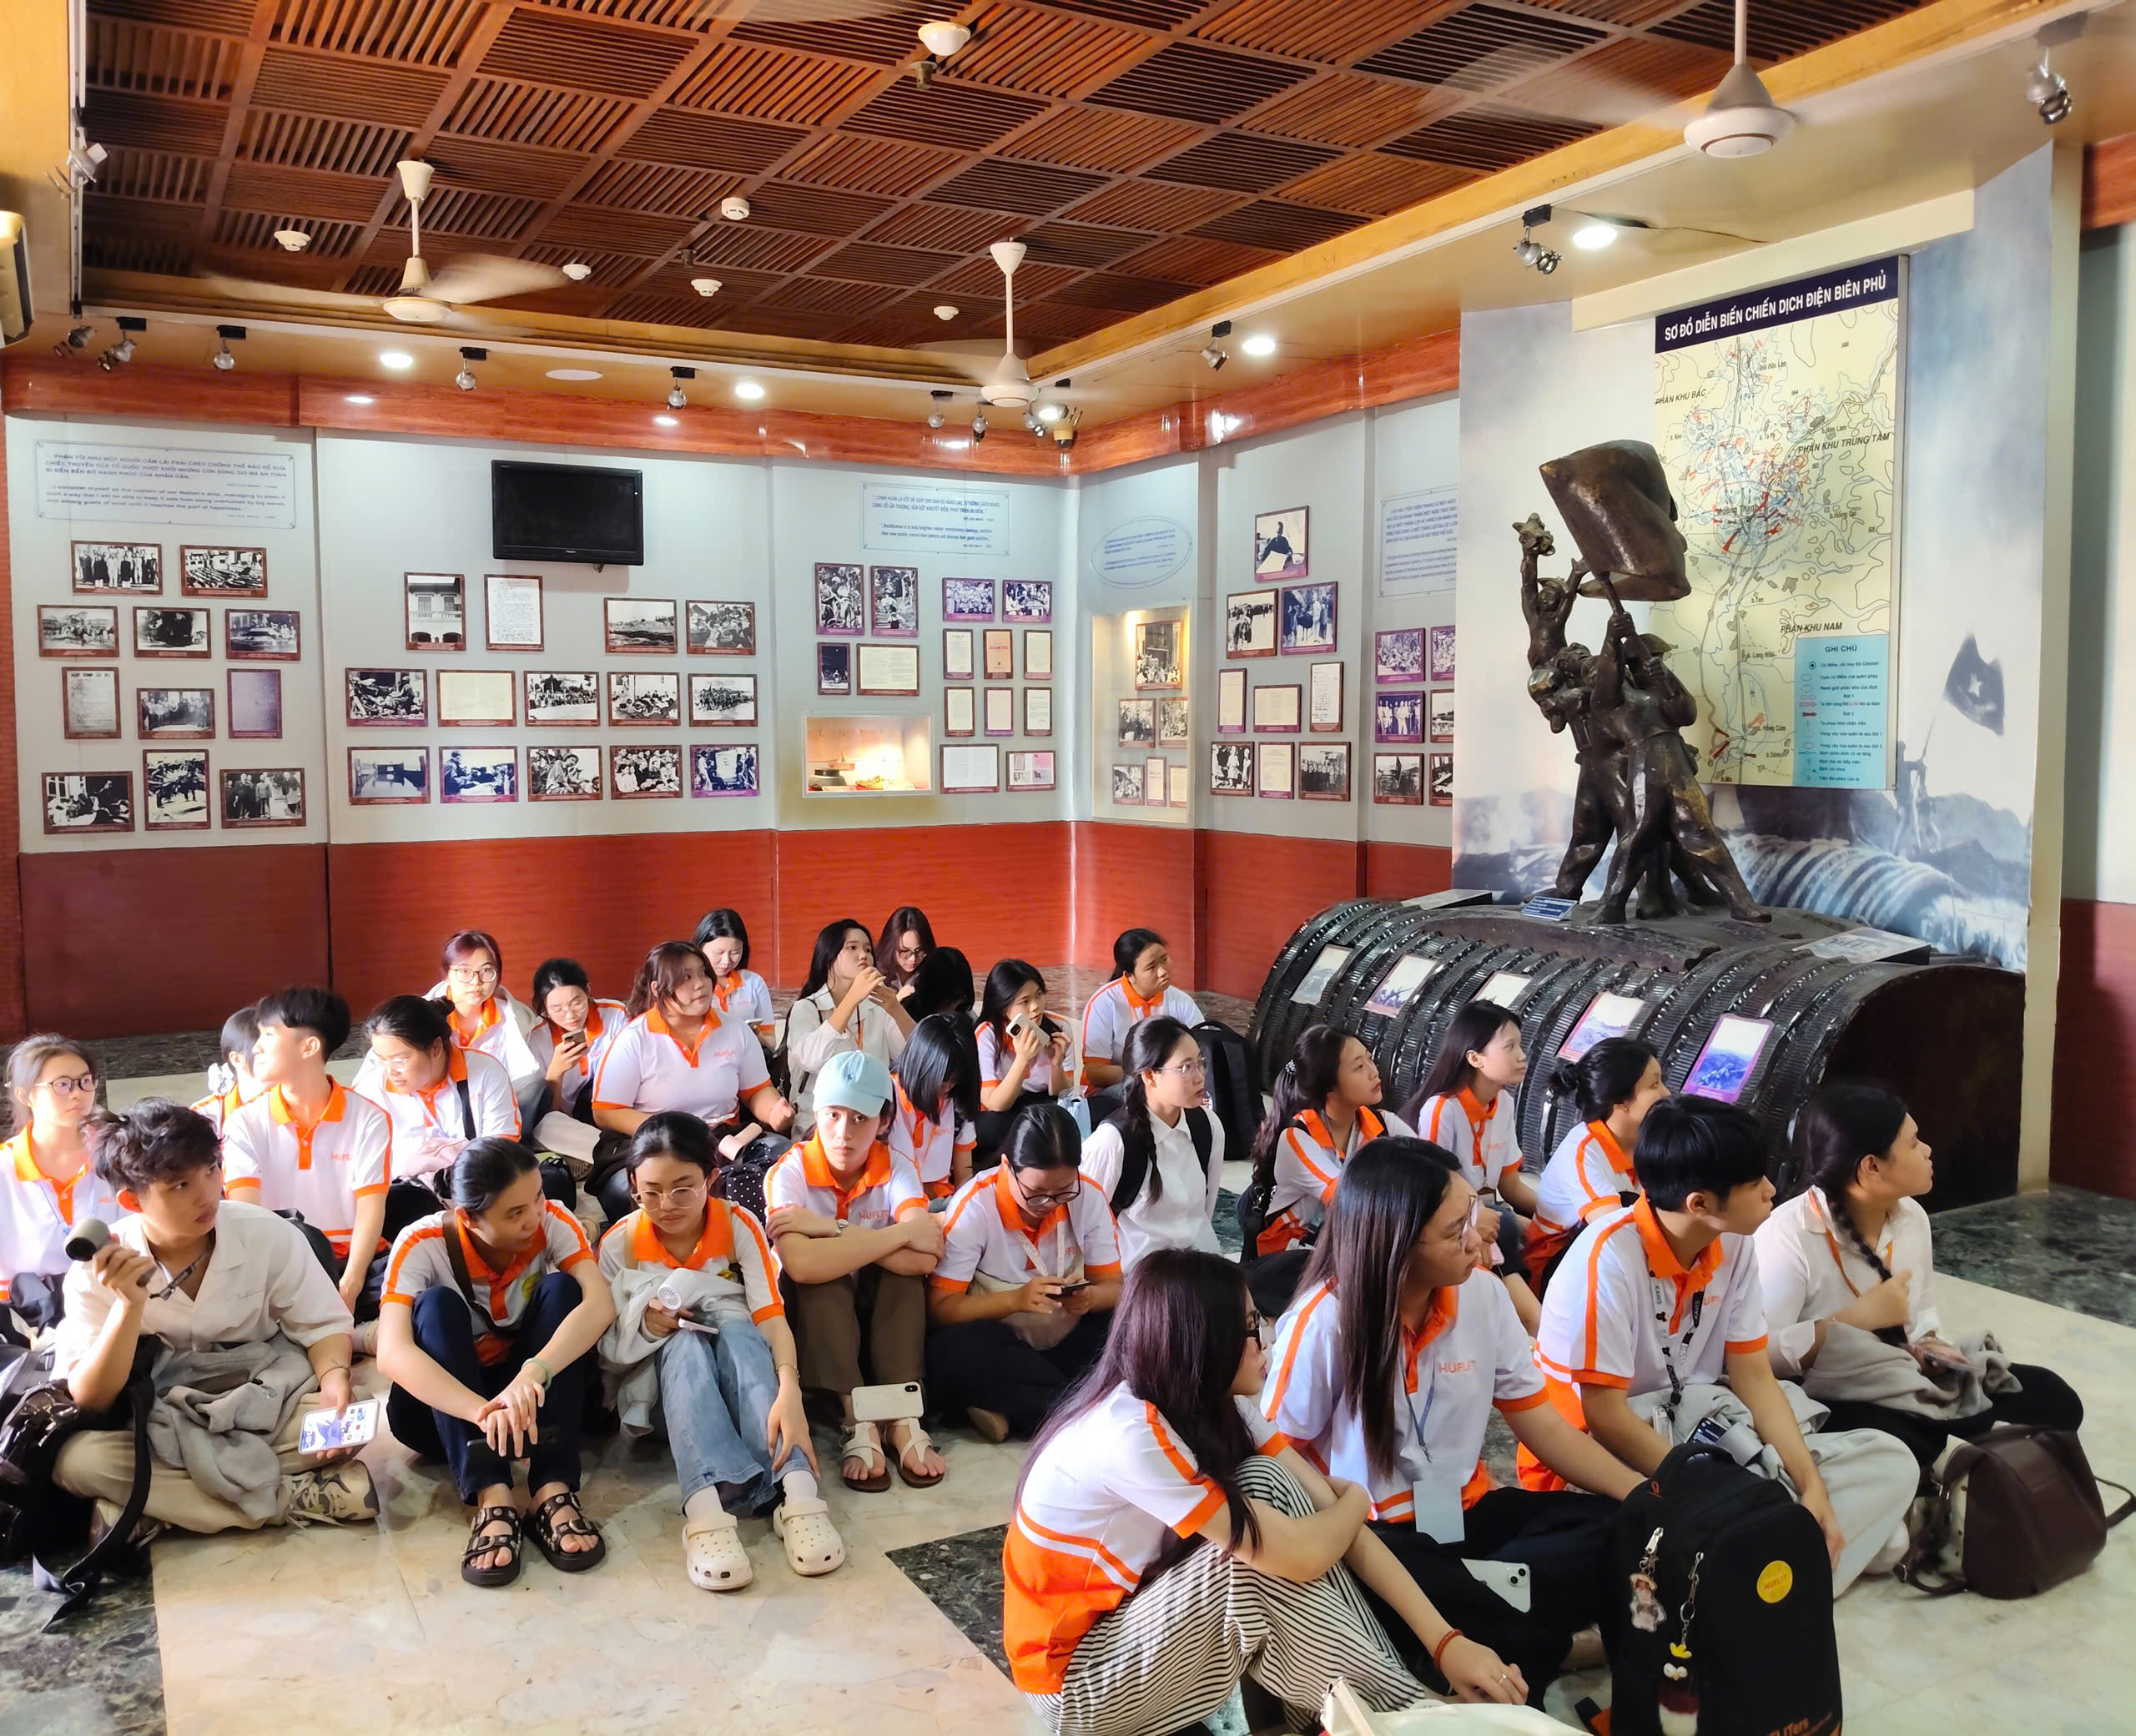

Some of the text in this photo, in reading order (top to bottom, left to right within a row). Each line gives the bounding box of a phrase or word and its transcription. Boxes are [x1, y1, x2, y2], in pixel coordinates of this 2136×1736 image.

[1665, 269, 1886, 341] SƠ ĐỒ DIỄN BIẾN CHIẾN DỊCH ĐIỆN BIÊN PHỦ
[1676, 392, 1690, 402] KHU
[1822, 440, 1840, 451] KHU
[1841, 435, 1870, 447] TRUNG
[1805, 623, 1822, 632] KHU
[1823, 622, 1843, 632] NAM
[1841, 643, 1857, 652] CHÚ
[1655, 1286, 1663, 1305] KAWS
